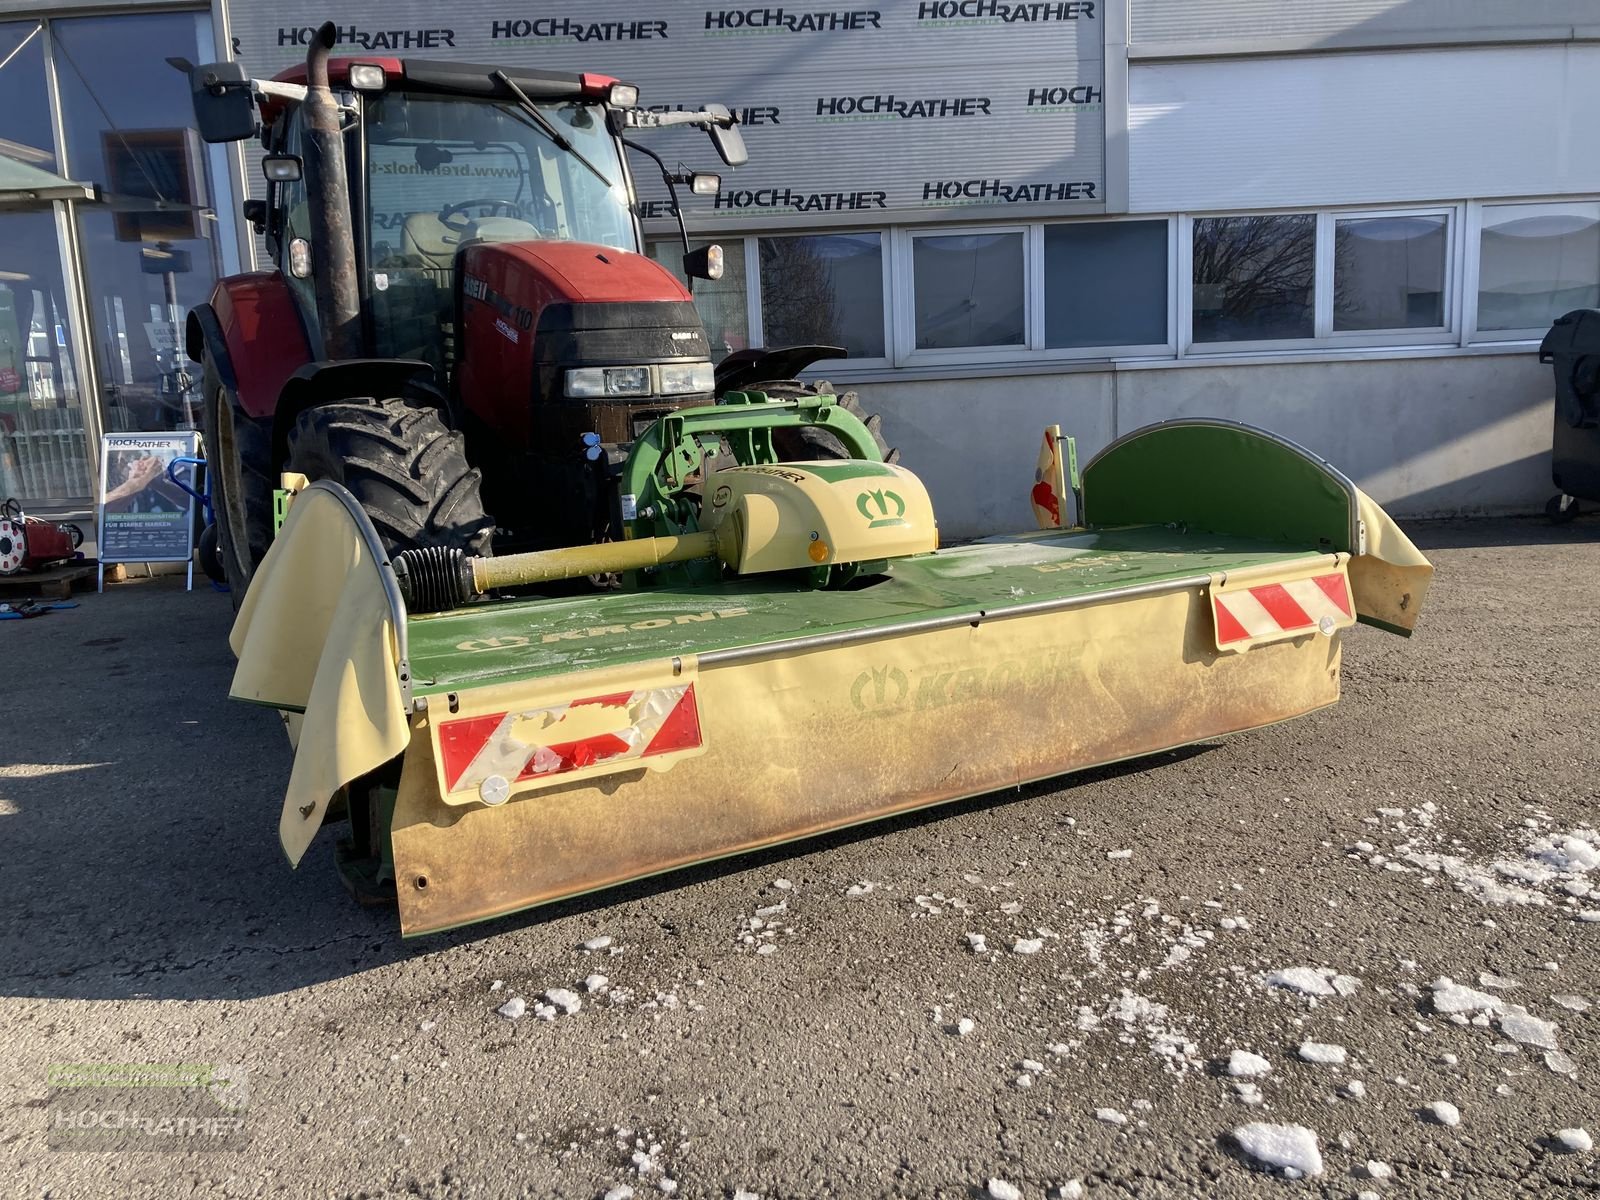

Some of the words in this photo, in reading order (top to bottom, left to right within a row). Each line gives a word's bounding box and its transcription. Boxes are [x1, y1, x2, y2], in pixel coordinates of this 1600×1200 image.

[705, 8, 882, 33] HOCHRATHER
[918, 0, 1095, 23] HOCHRATHER
[278, 26, 455, 50] HOHRATHER
[491, 18, 669, 42] HOCHRATHER
[816, 95, 991, 119] HOCHRATHER
[714, 188, 887, 212] HOCHRATHER
[923, 179, 1096, 203] HOCHRATHER
[108, 439, 171, 448] HOCHRATHER
